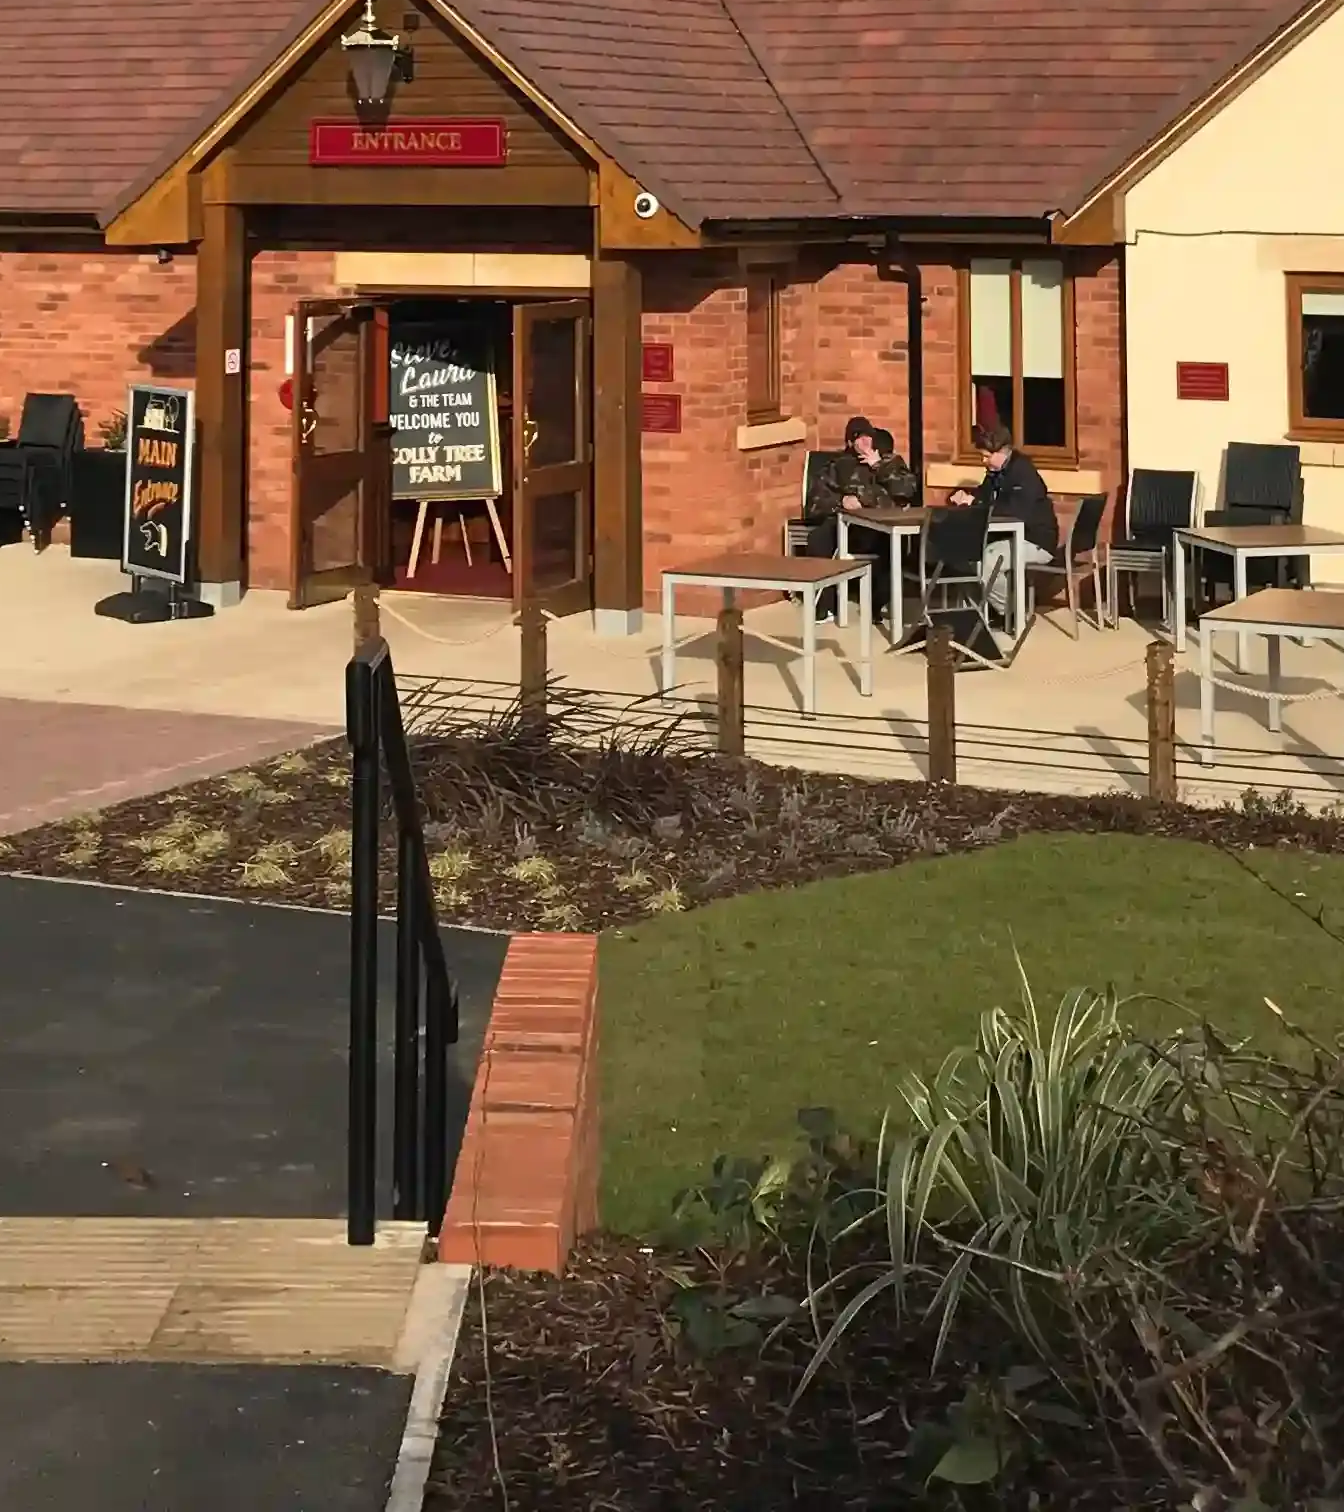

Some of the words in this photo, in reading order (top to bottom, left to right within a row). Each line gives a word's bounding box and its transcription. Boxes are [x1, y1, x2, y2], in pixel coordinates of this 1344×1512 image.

[351, 131, 463, 151] ENTRANCE
[408, 395, 418, 408] &
[419, 393, 440, 408] THE
[442, 392, 473, 407] TEAM
[455, 411, 480, 428] YOU
[428, 431, 444, 445] to
[137, 438, 178, 468] MAIN
[442, 444, 486, 463] TREE
[409, 464, 462, 484] FARM
